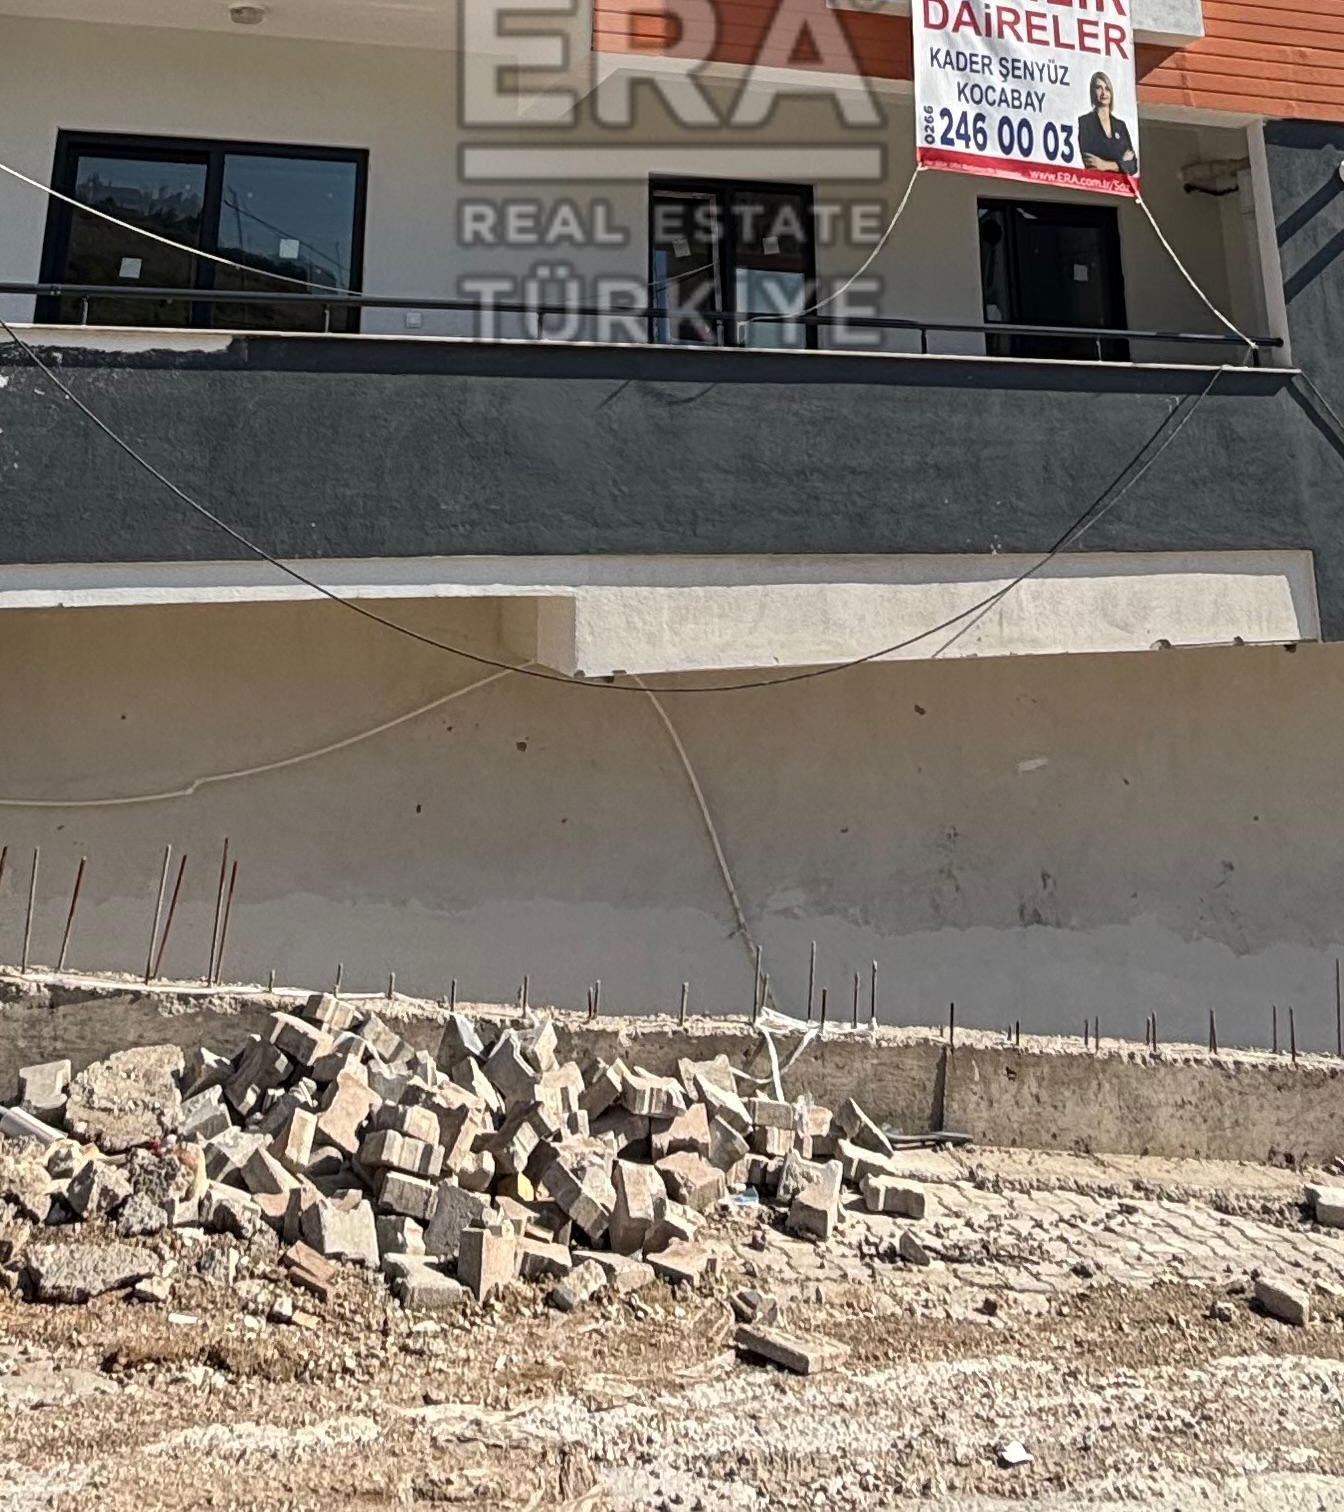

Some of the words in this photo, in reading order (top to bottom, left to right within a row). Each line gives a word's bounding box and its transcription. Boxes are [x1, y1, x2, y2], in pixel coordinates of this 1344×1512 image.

[930, 47, 993, 76] KADER
[998, 57, 1071, 87] ŞENYÜZ
[957, 81, 1046, 113] KOCABAY
[923, 105, 936, 145] 0266
[939, 107, 988, 152] 246
[997, 115, 1034, 158] 00
[1043, 121, 1075, 164] 03
